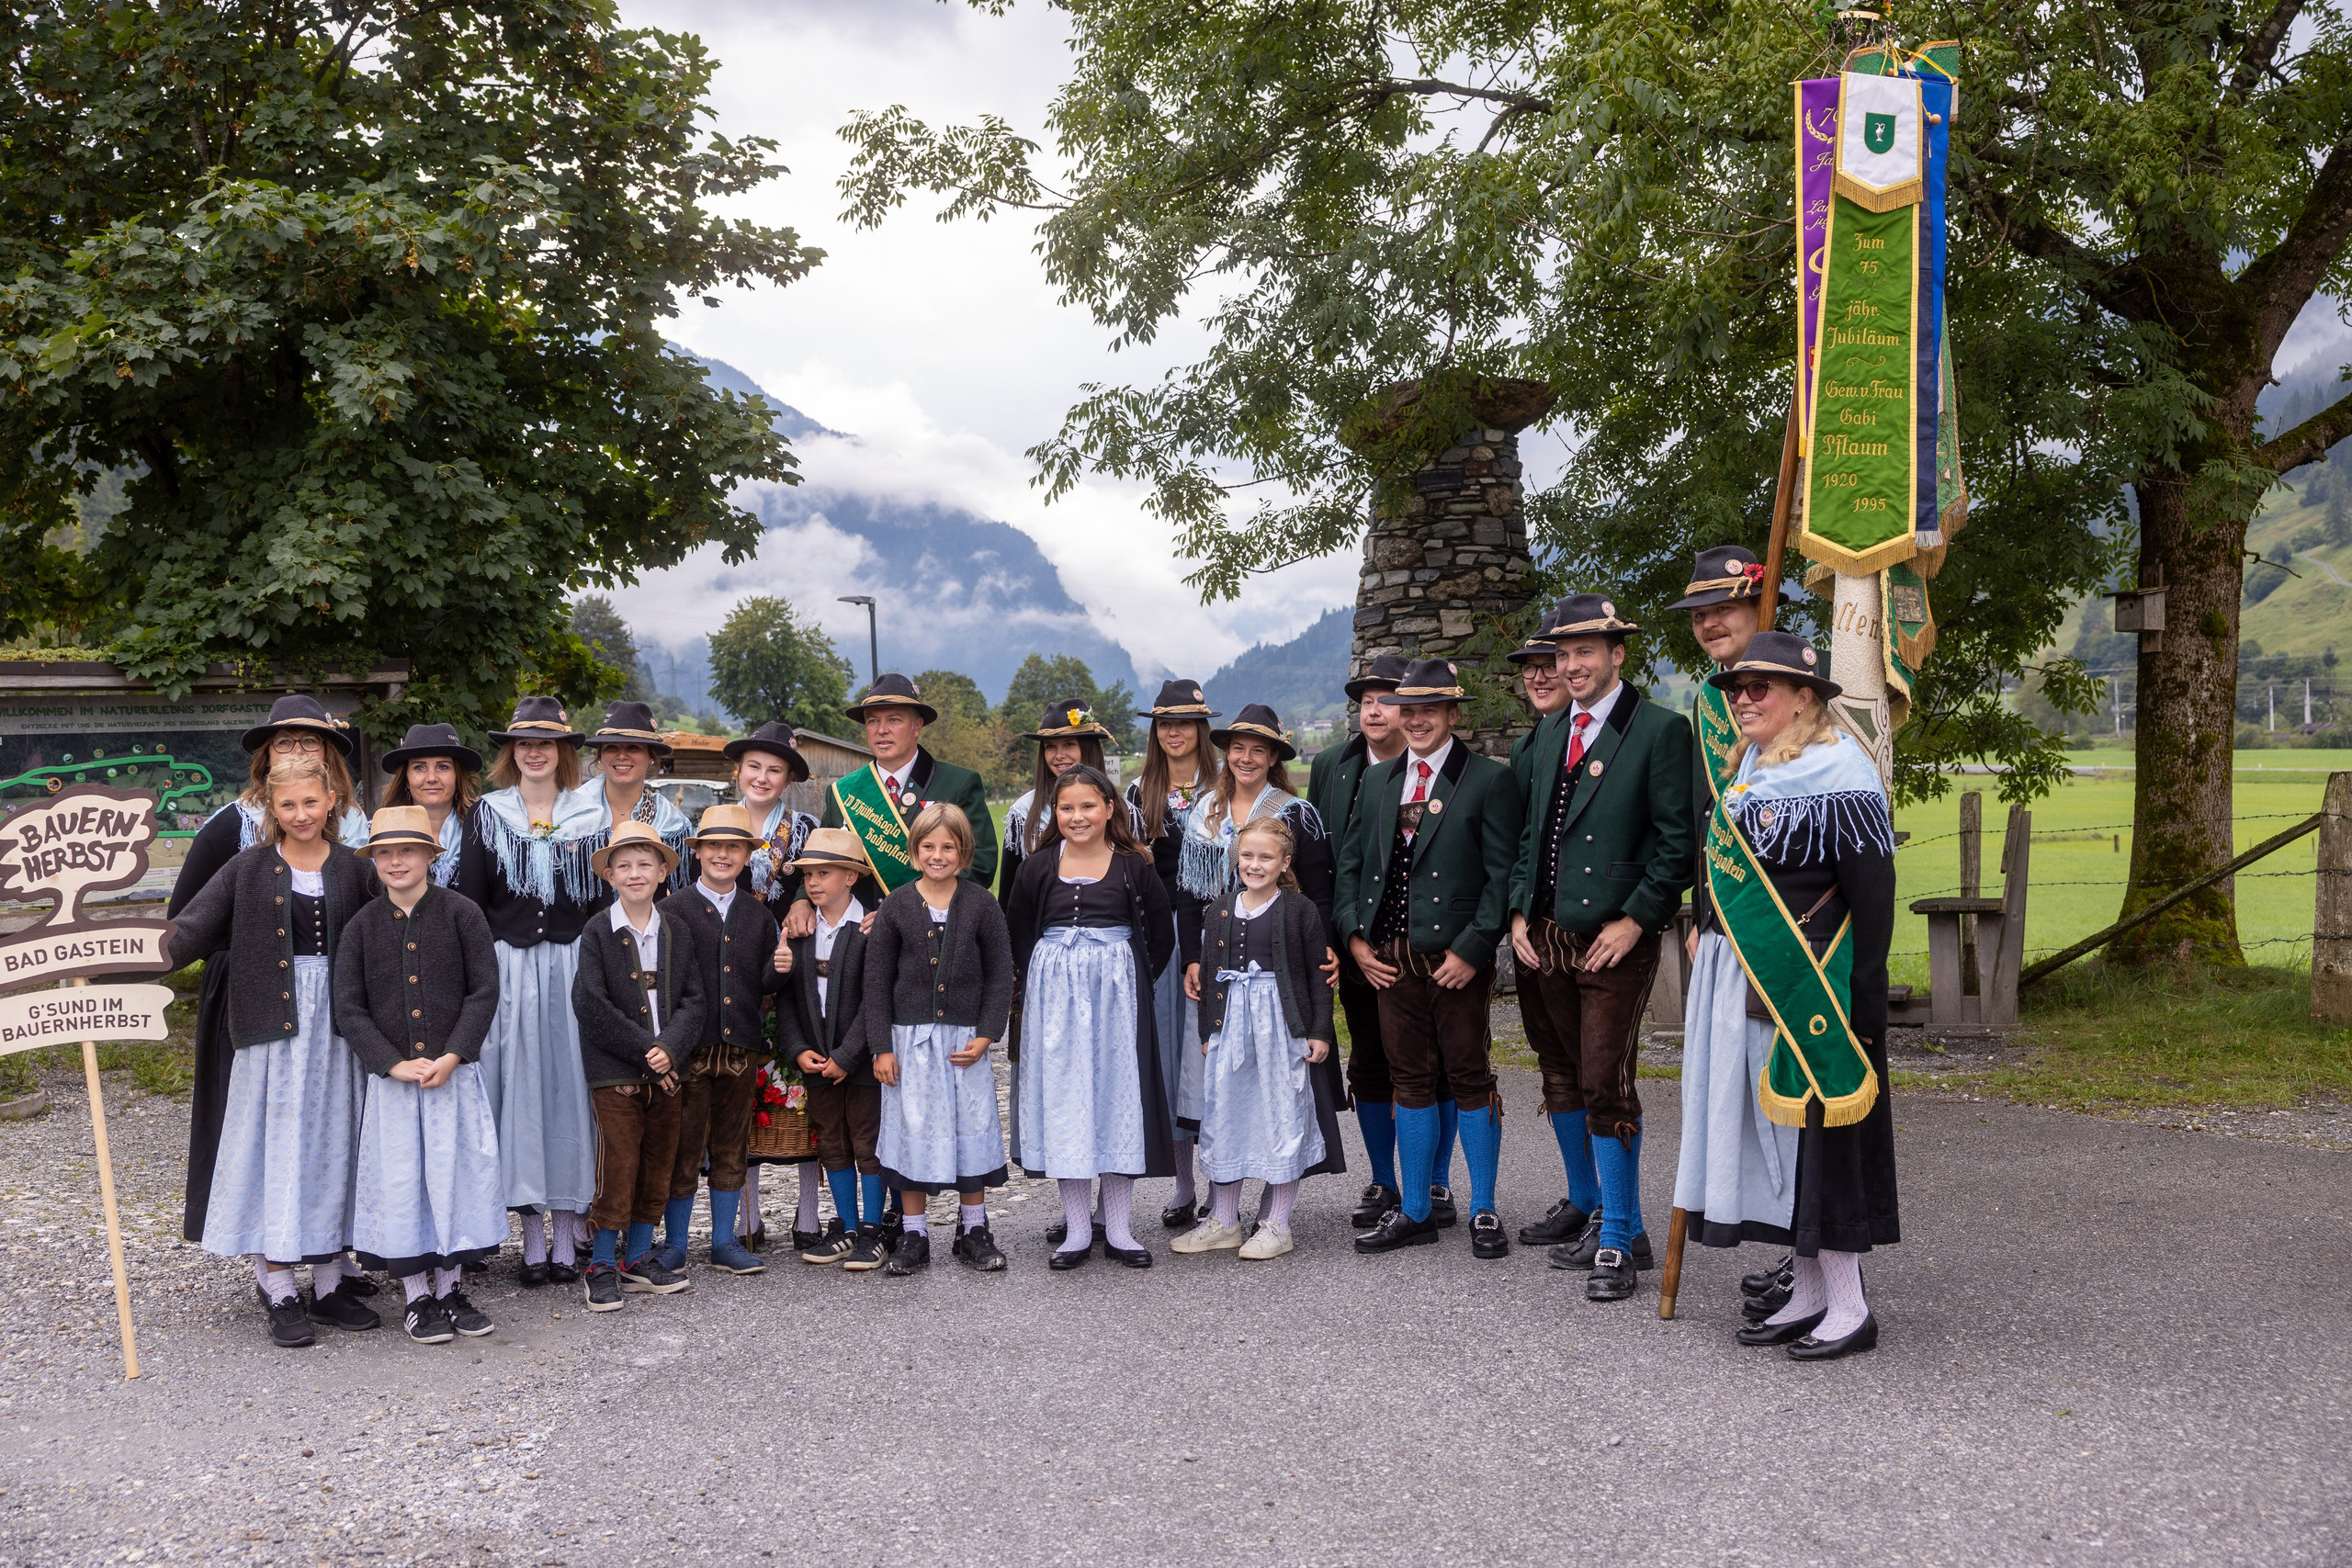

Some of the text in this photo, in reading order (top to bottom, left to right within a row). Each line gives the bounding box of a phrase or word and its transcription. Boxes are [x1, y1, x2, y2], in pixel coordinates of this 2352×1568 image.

[1852, 232, 1885, 252] Zum
[1860, 261, 1878, 274] 75
[1826, 327, 1902, 349] Jubiläum
[1839, 409, 1877, 426] Gabi
[1822, 434, 1892, 461] Pflaum
[1823, 473, 1858, 489] 1920
[1853, 497, 1886, 513] 1995
[79, 706, 93, 716] IM
[100, 705, 195, 716] NATURERLEBNIS
[19, 807, 140, 853] BAUERN
[22, 840, 130, 883] HERBST
[4, 938, 144, 973] BAD GASTEIN
[103, 998, 123, 1011] IM
[2, 1014, 152, 1043] BAUERNHERBST
